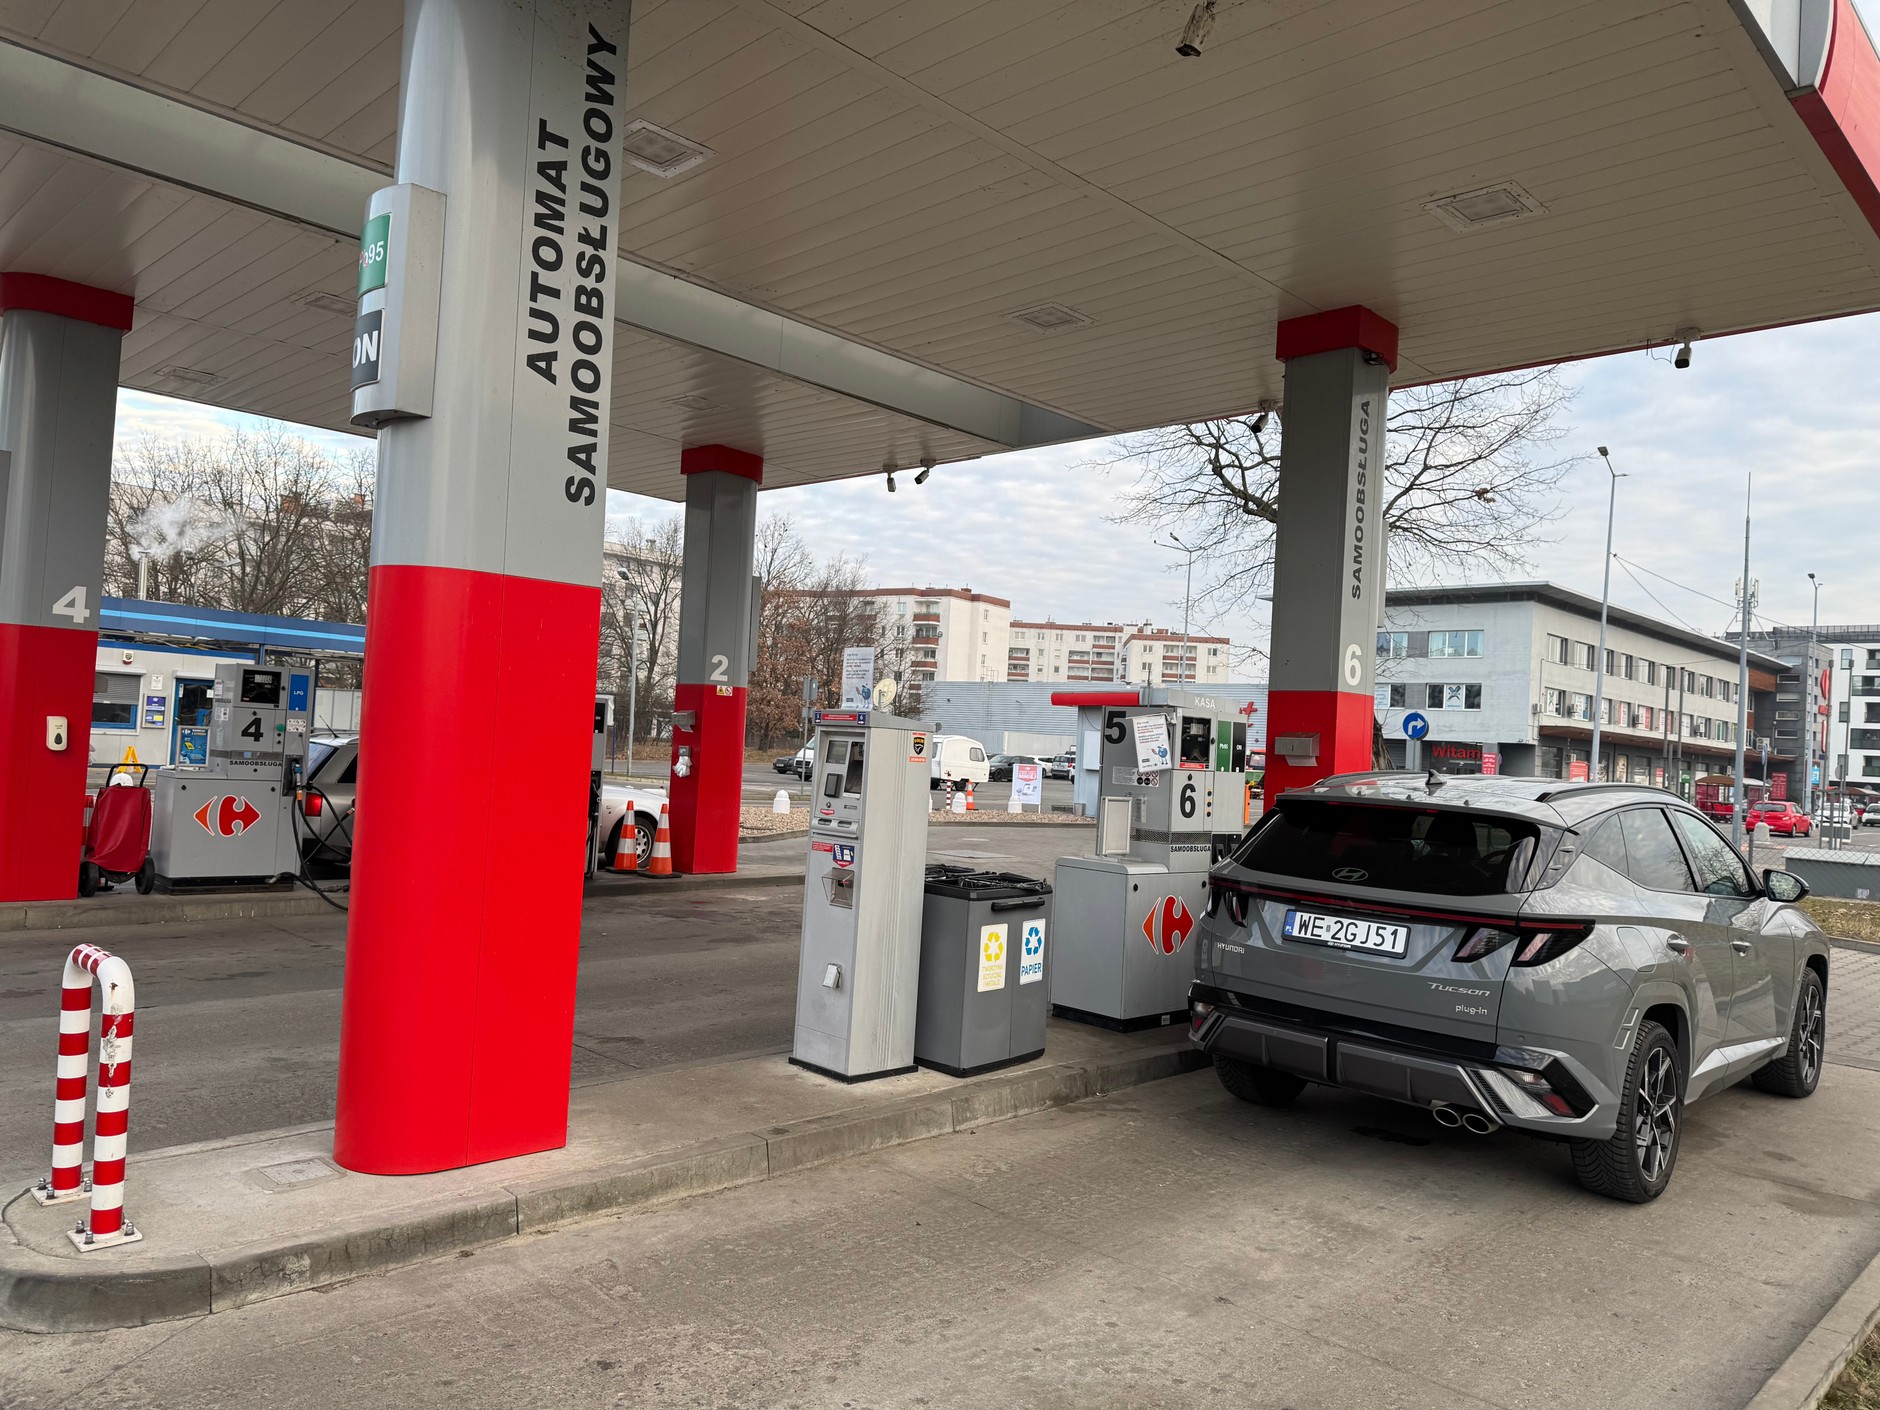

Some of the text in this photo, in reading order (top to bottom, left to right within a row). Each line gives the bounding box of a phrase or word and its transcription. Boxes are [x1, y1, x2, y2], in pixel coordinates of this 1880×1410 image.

[526, 118, 569, 385] AUTOMAT
[565, 22, 619, 506] SAMOOBSŁUGOWY
[352, 330, 379, 369] ON
[1351, 400, 1370, 600] SAMOOBSŁUGA
[52, 585, 90, 624] 4
[710, 654, 729, 682] 2
[1344, 643, 1363, 686] 6
[1194, 696, 1216, 709] KASA
[240, 717, 264, 743] 4
[1104, 710, 1127, 745] 5
[1431, 744, 1482, 759] Witam
[1180, 783, 1197, 818] 6
[1170, 845, 1211, 853] SAMOOBSŁUGA
[1217, 942, 1245, 954] HYUNDAI
[1298, 914, 1399, 950] WE 2GJ51
[1021, 962, 1042, 976] PAPIER
